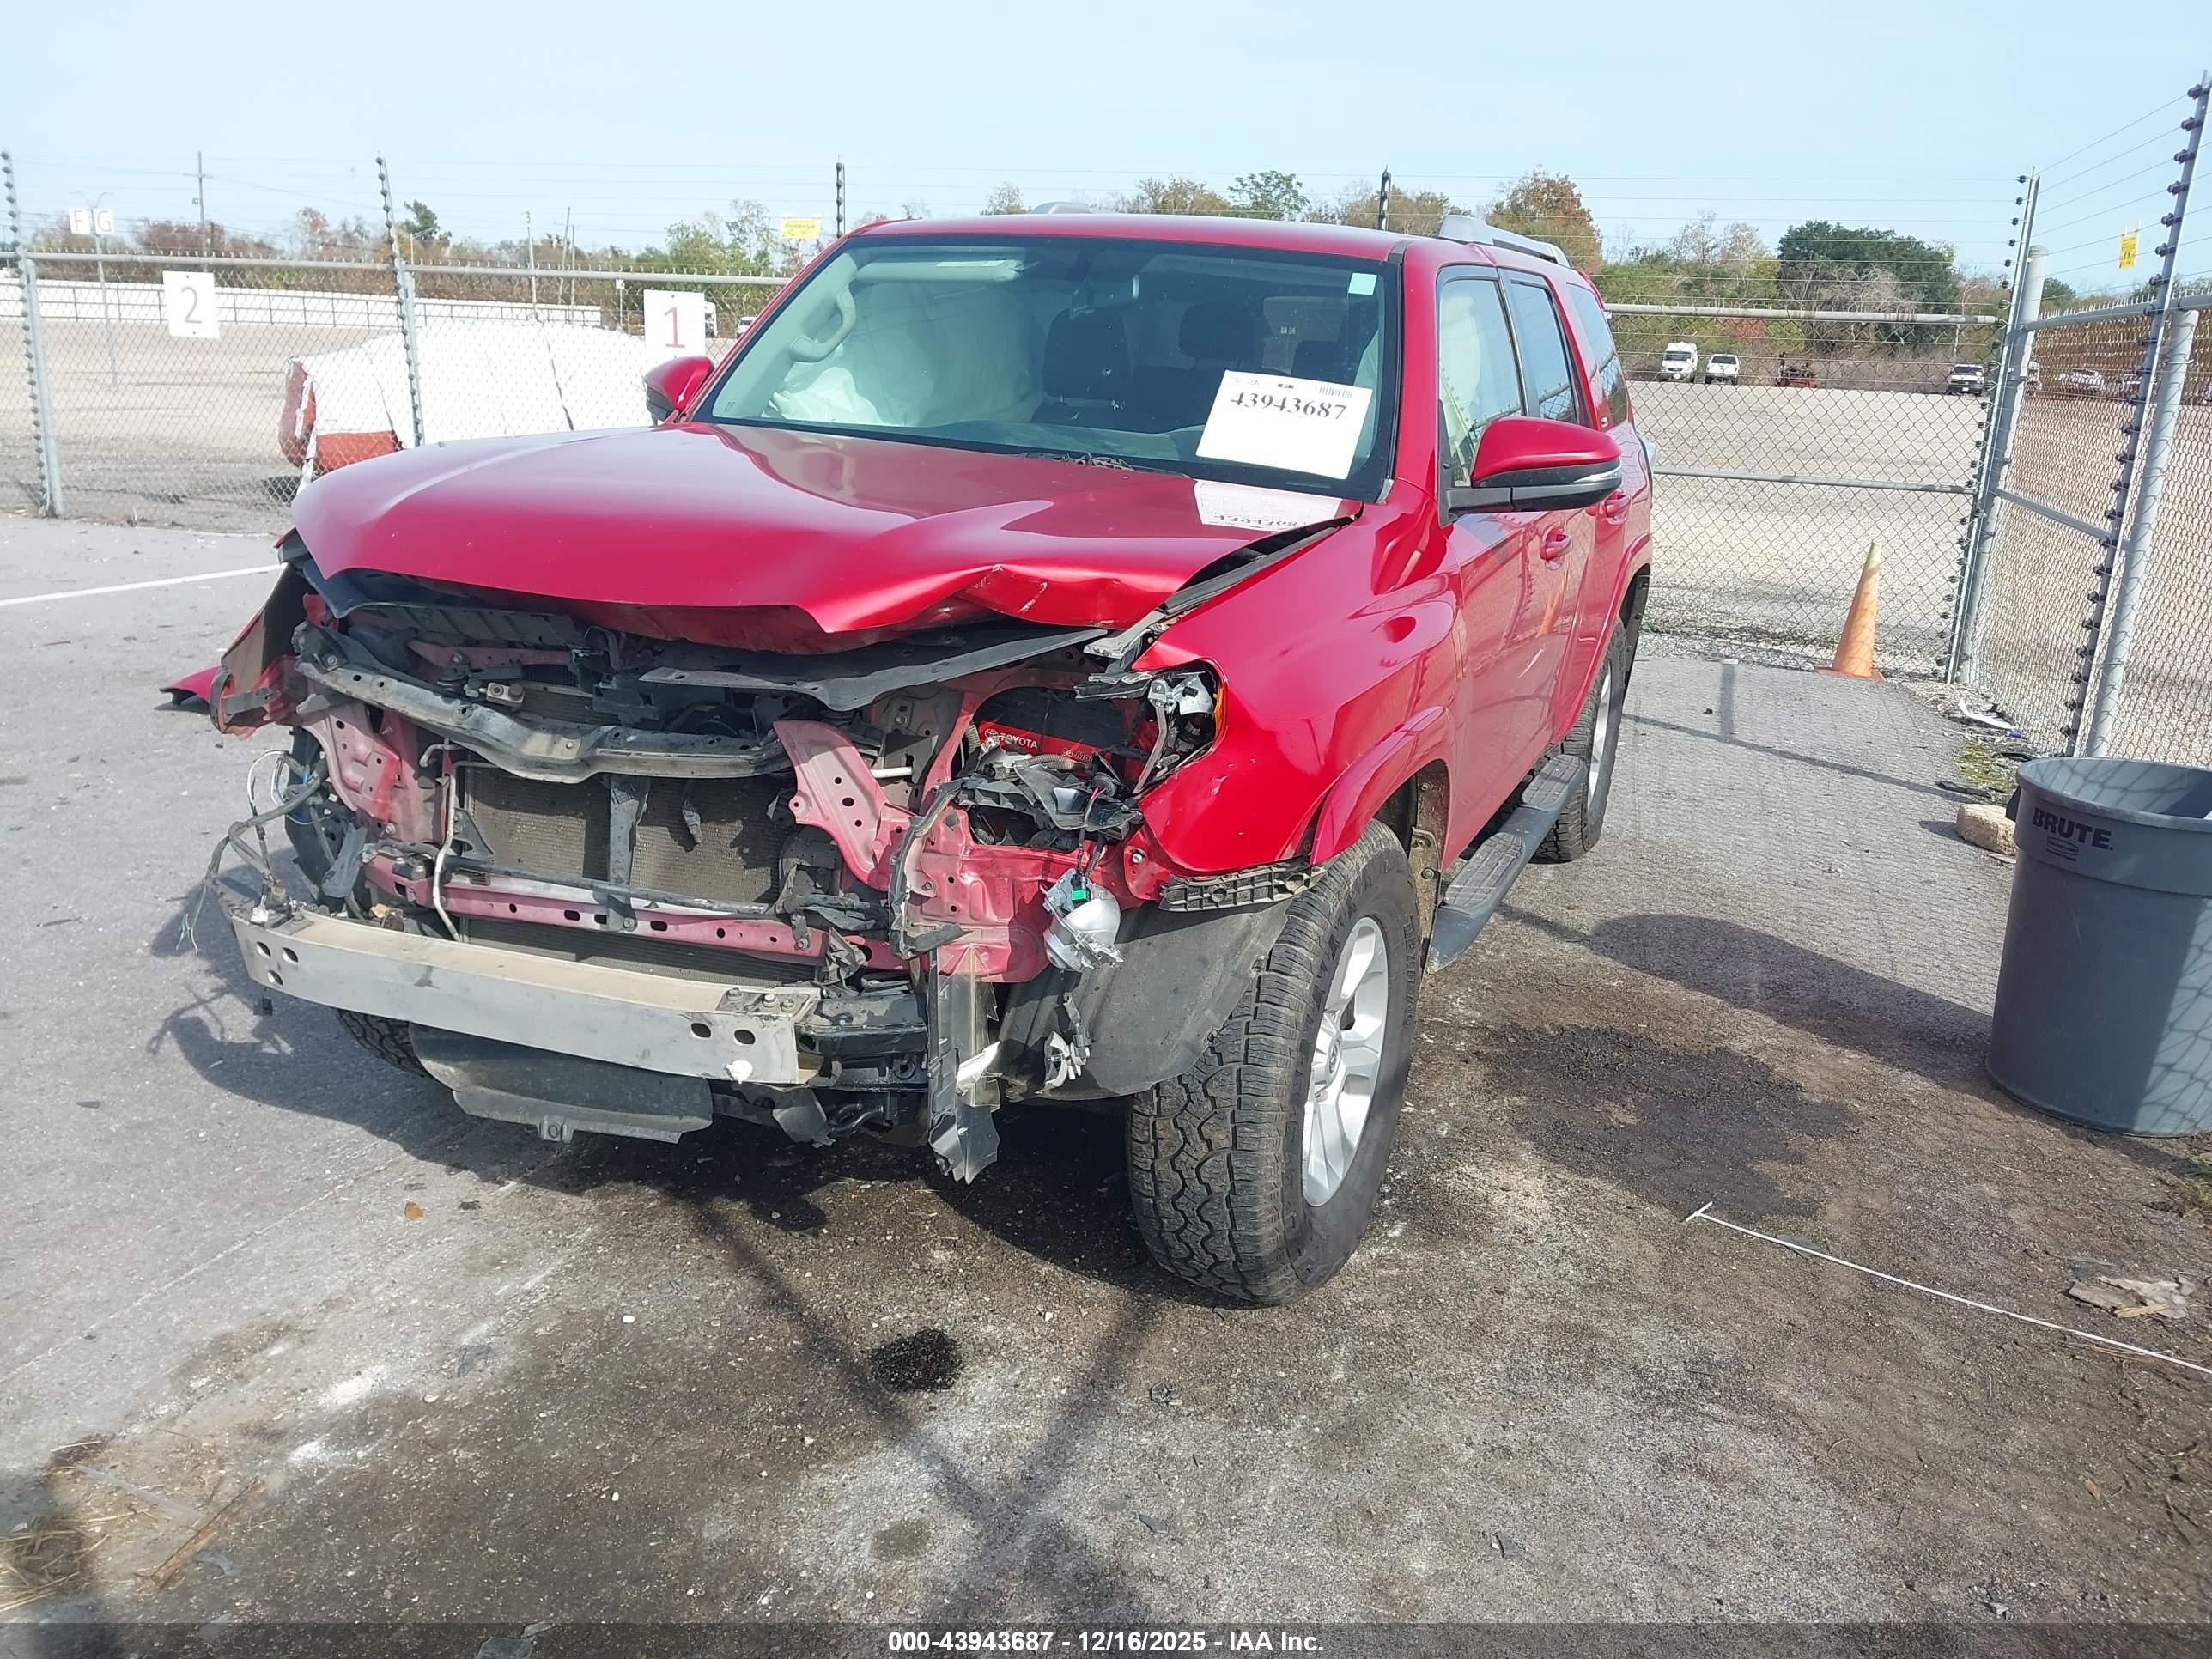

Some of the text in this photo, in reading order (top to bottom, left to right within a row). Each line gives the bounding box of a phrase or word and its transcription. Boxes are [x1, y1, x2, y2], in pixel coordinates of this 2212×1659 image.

[74, 210, 83, 231] F
[97, 210, 112, 232] G
[181, 286, 203, 324] 2
[665, 307, 685, 348] 1
[1231, 391, 1347, 420] 43943687
[999, 732, 1038, 750] TOYOTA
